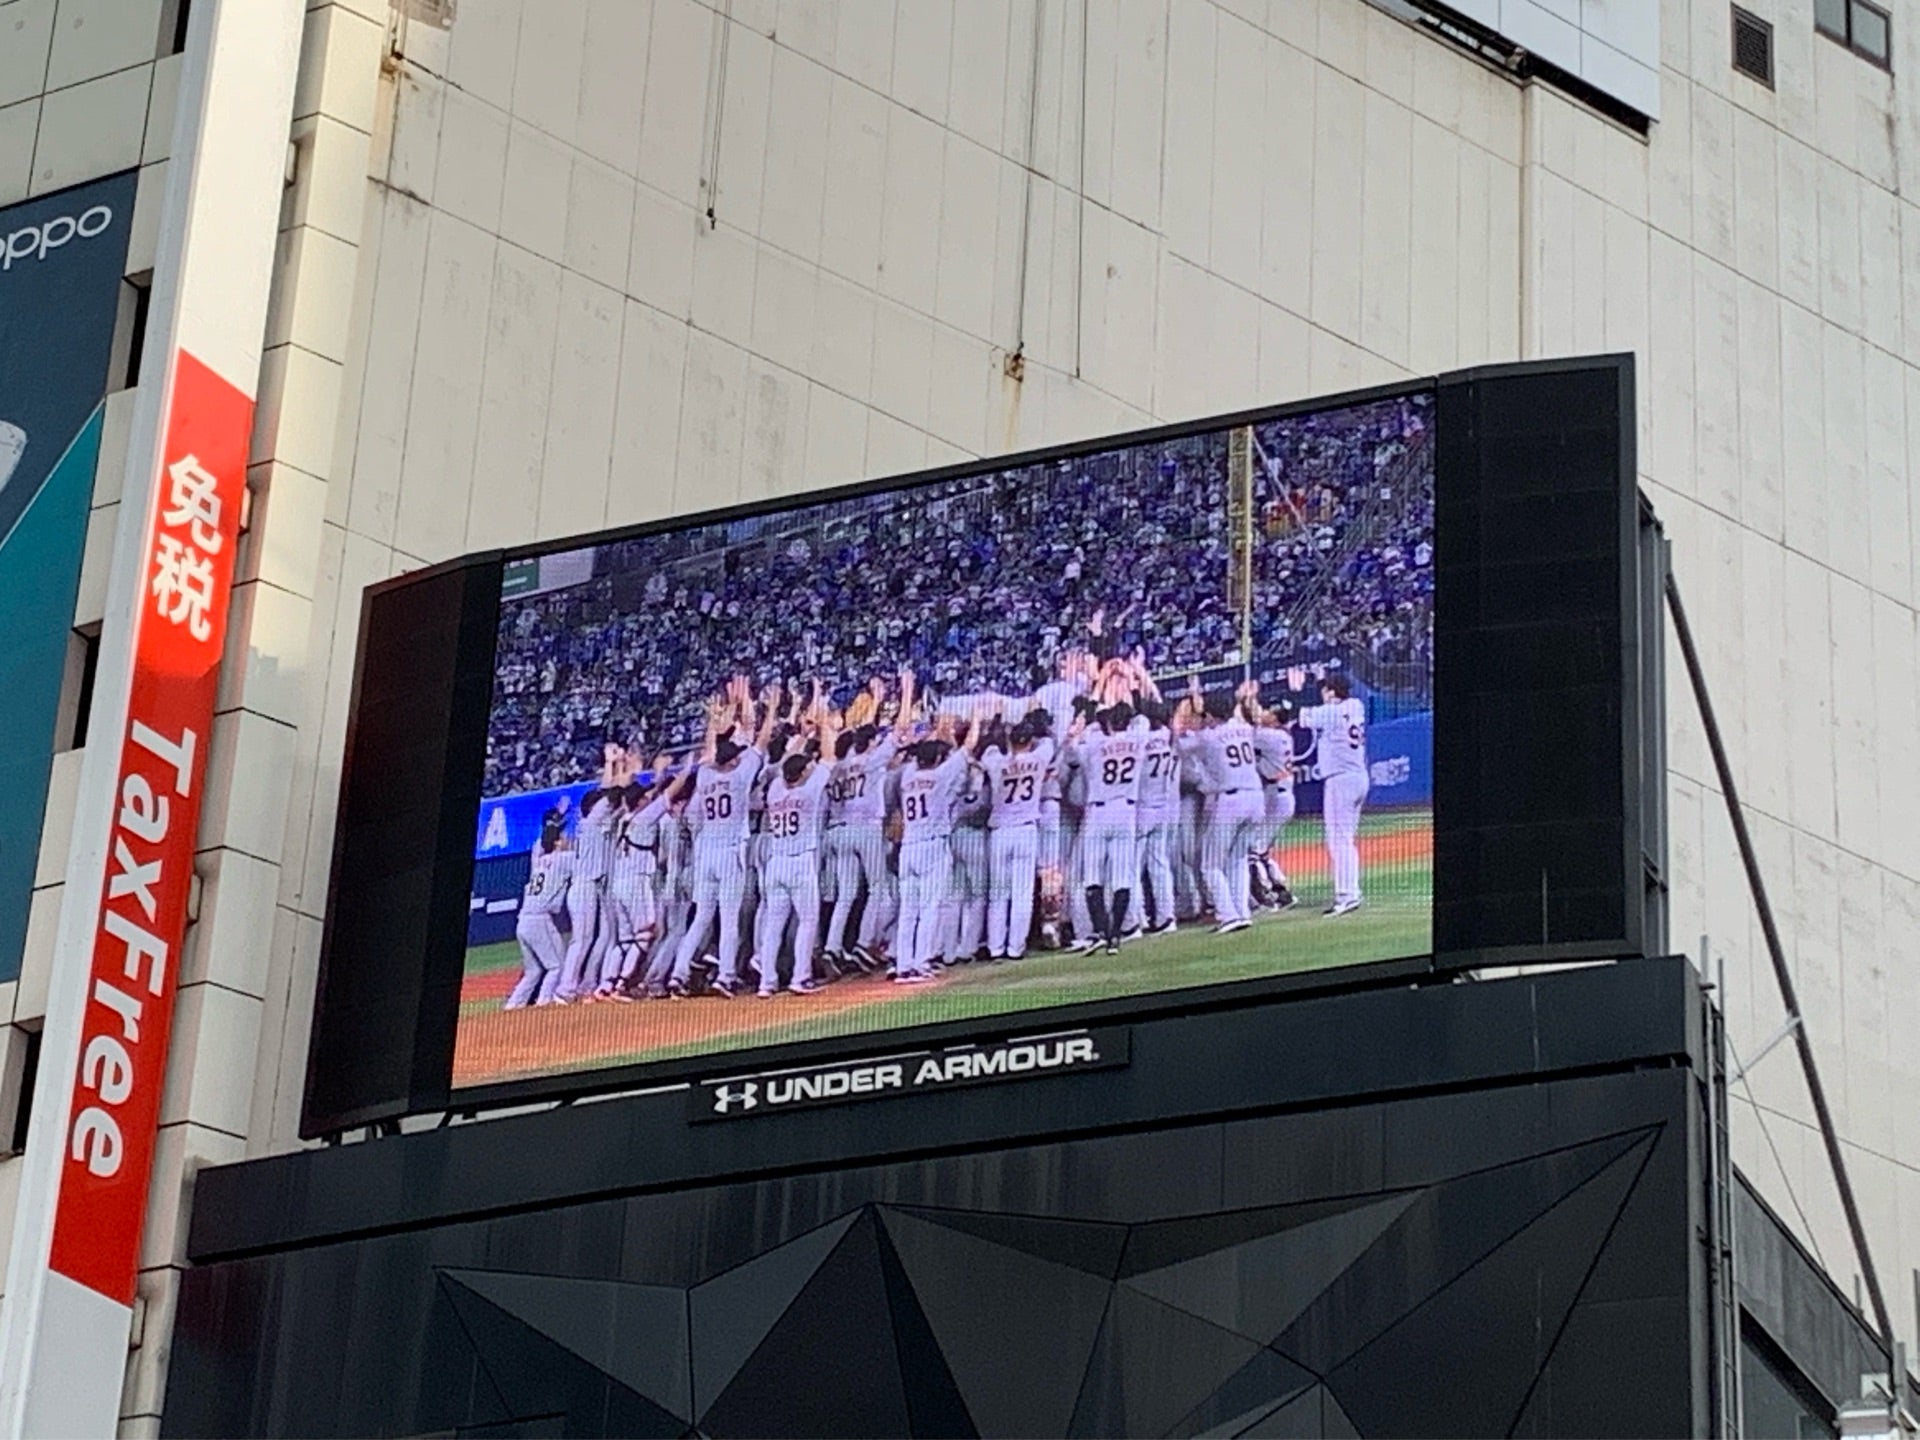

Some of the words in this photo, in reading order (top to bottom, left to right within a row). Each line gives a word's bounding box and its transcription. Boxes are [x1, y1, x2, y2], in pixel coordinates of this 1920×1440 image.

[0, 205, 112, 270] ppo
[152, 454, 222, 642] 免税
[1102, 756, 1136, 785] 82
[1226, 741, 1253, 768] 90
[1003, 775, 1034, 804] 73
[906, 793, 928, 821] 81
[72, 719, 196, 1178] TaxFree
[767, 1064, 901, 1104] UNDER
